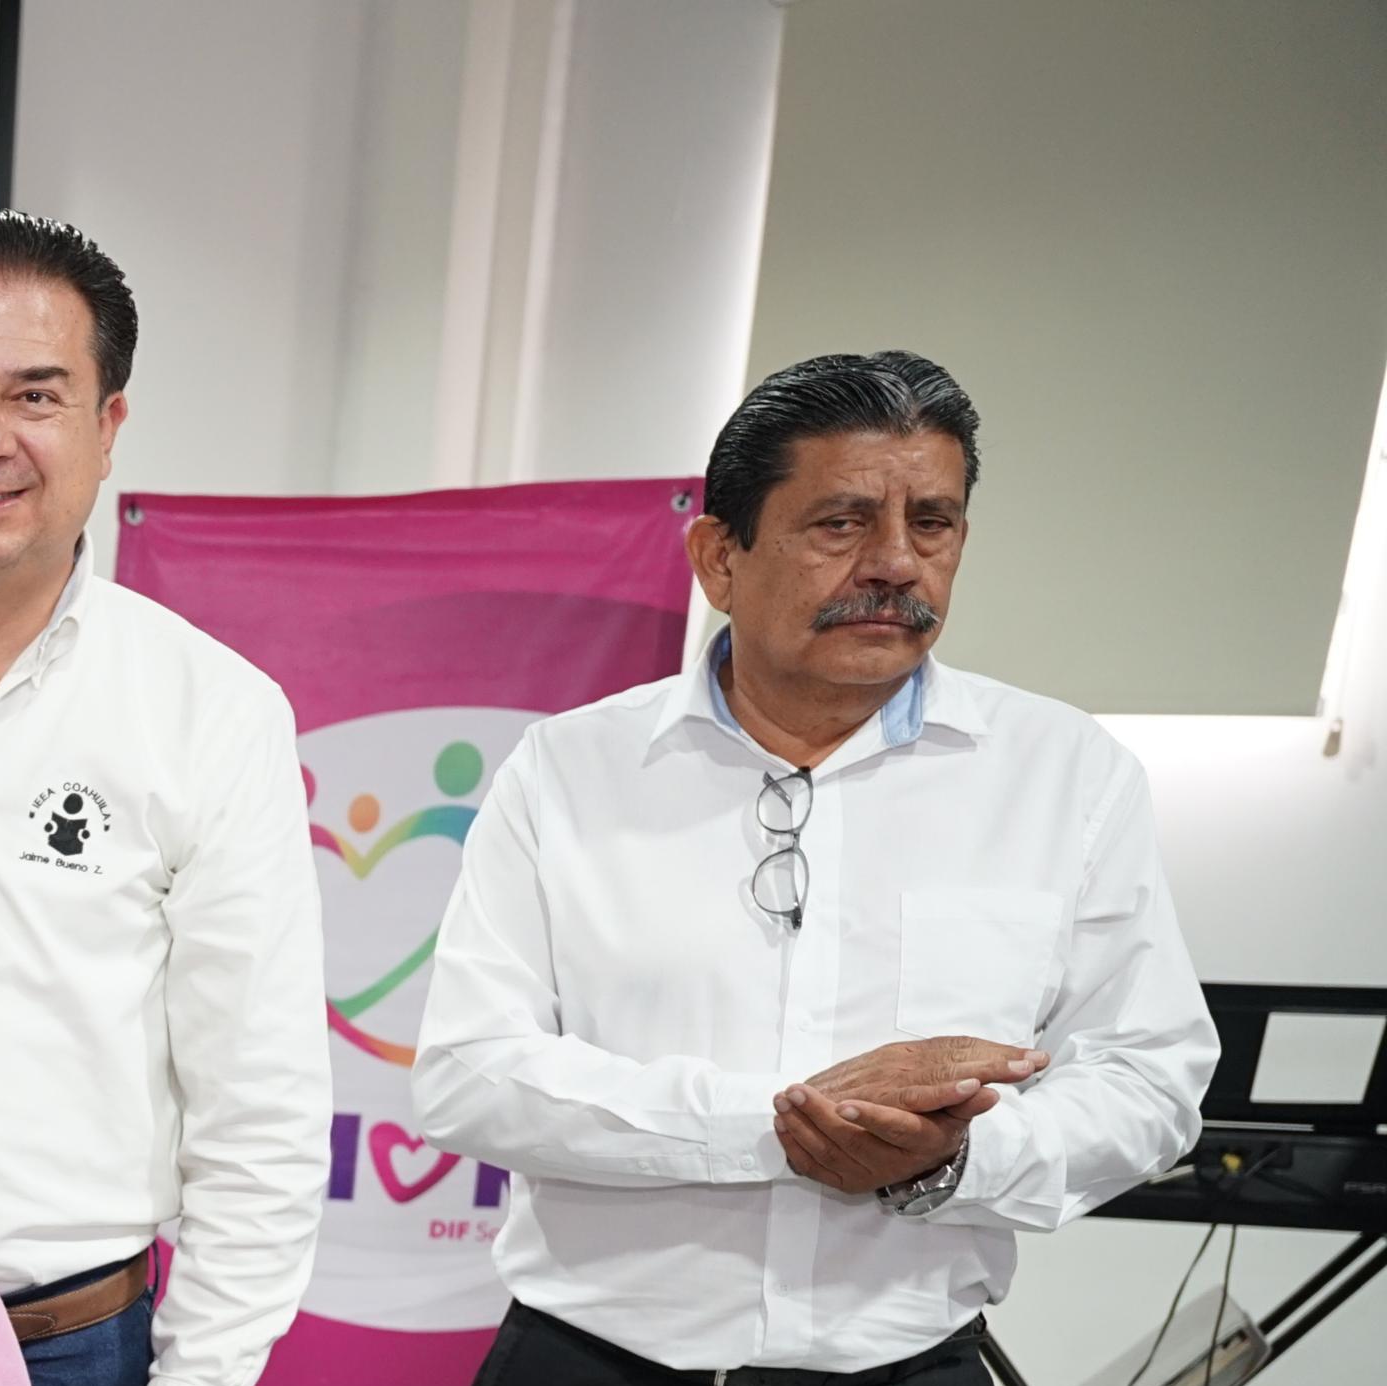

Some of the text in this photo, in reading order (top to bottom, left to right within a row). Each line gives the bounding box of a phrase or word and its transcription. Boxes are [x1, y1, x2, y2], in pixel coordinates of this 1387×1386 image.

[32, 782, 111, 821] IEEA COAHUILA
[19, 850, 50, 865] Jaime
[55, 857, 88, 873] Bueno
[429, 1219, 471, 1240] DIF
